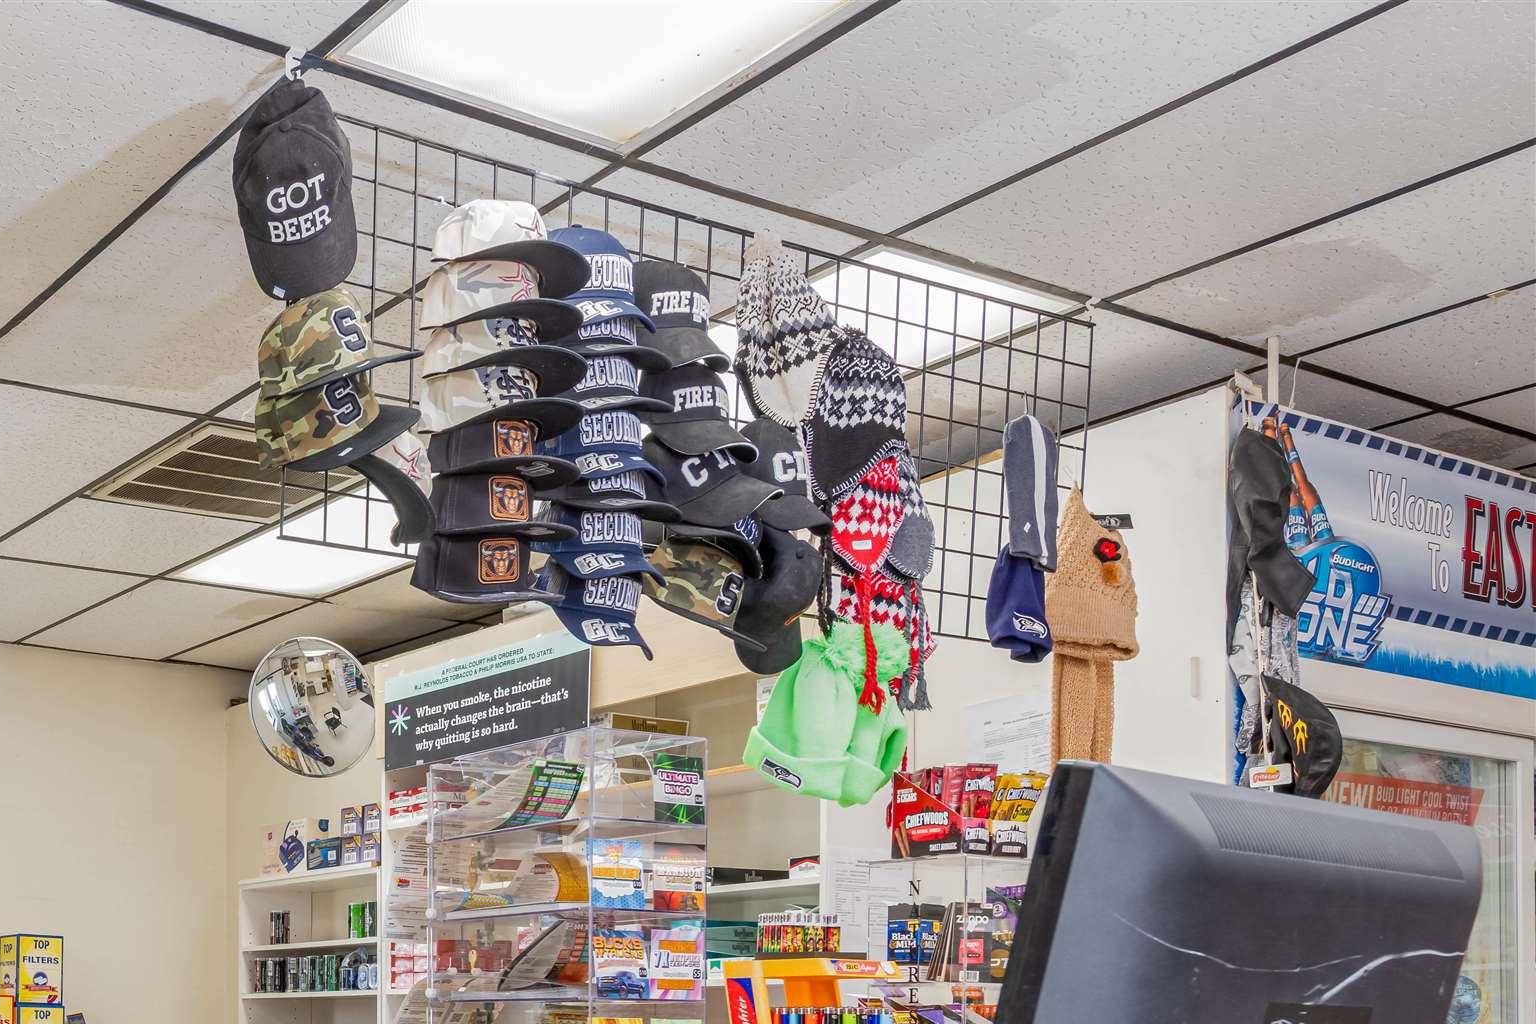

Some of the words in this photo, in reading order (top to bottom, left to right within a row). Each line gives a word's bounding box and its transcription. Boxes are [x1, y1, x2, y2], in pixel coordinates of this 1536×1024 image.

[266, 172, 325, 213] GOT
[268, 205, 332, 243] BEER
[651, 291, 691, 317] FIRE
[331, 306, 368, 352] S
[323, 379, 363, 427] S
[673, 385, 705, 413] FIRE
[1369, 470, 1454, 538] Welcome
[1288, 513, 1305, 525] BUD
[1427, 541, 1449, 593] To
[717, 572, 743, 617] S
[469, 658, 486, 669] COURT
[487, 655, 497, 665] HAS
[498, 647, 524, 660] ORDERED
[423, 677, 449, 688] REYNOLDS
[449, 671, 473, 684] TOBACCO
[478, 665, 494, 675] PHILIP
[495, 659, 516, 670] MORRIS
[516, 656, 527, 665] USA
[416, 706, 442, 718] When
[443, 702, 459, 715] you
[460, 692, 493, 708] smoke,
[494, 686, 510, 699] the
[511, 675, 552, 695] nicotine
[415, 712, 450, 734] actually
[451, 710, 487, 727] changes
[488, 705, 504, 717] the
[416, 739, 434, 752] why
[435, 728, 470, 751] quitting
[472, 727, 480, 738] is
[481, 726, 491, 736] so
[492, 719, 518, 734] hard.
[657, 770, 698, 784] ULTIMATE
[664, 784, 692, 796] BINGO
[1376, 785, 1394, 802] BUD
[1396, 789, 1421, 806] LIGHT
[1422, 792, 1443, 808] COOL
[1446, 795, 1469, 810] TWIST
[905, 811, 949, 829] CHIEFWOODS
[3, 943, 13, 954] TOP
[34, 940, 50, 949] TOP
[593, 936, 643, 950] BUCKS
[23, 956, 59, 965] FILTERS
[34, 1010, 51, 1020] TOP
